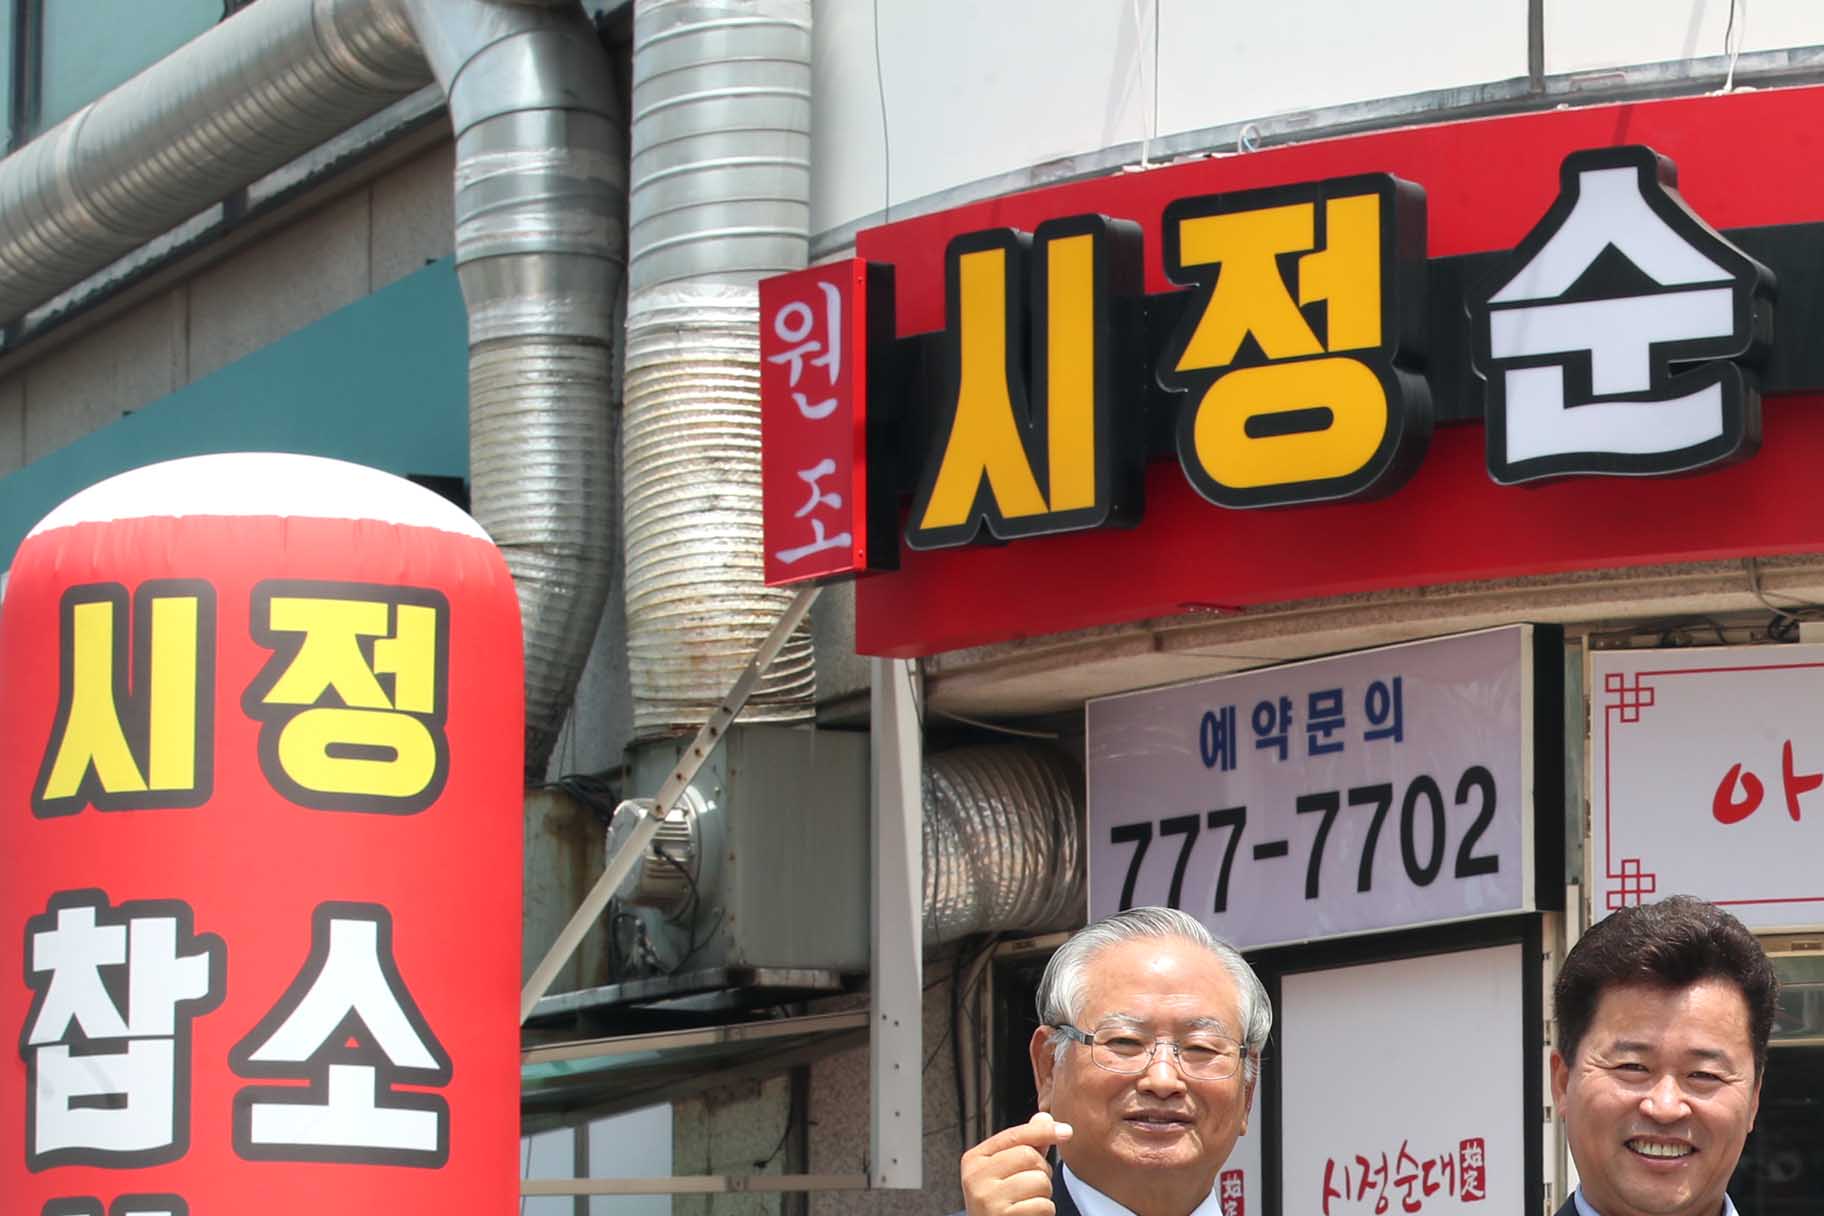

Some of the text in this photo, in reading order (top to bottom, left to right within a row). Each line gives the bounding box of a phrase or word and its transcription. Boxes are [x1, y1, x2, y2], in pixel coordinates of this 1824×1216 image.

[768, 282, 851, 564] 원조
[42, 595, 437, 797] 시정
[1200, 676, 1404, 771] 예약문의
[1110, 765, 1499, 912] 777-7702
[1322, 1140, 1455, 1216] 시정순대
